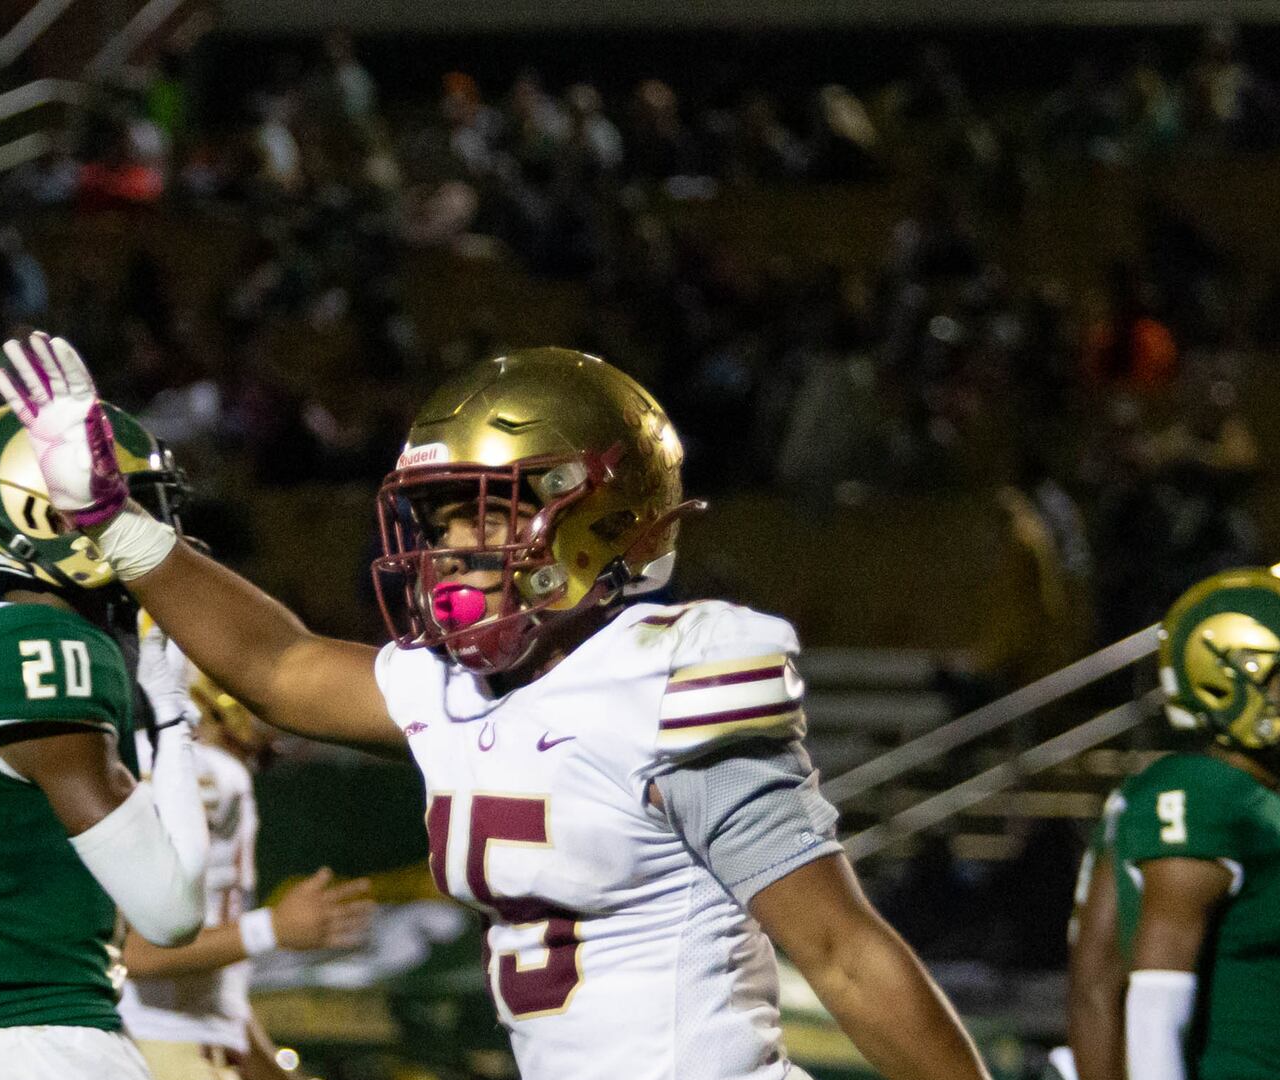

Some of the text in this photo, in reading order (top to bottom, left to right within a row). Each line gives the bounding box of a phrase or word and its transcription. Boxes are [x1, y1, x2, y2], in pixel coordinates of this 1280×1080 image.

[18, 638, 91, 699] 20
[1156, 789, 1186, 844] 9
[425, 789, 585, 1022] 15
